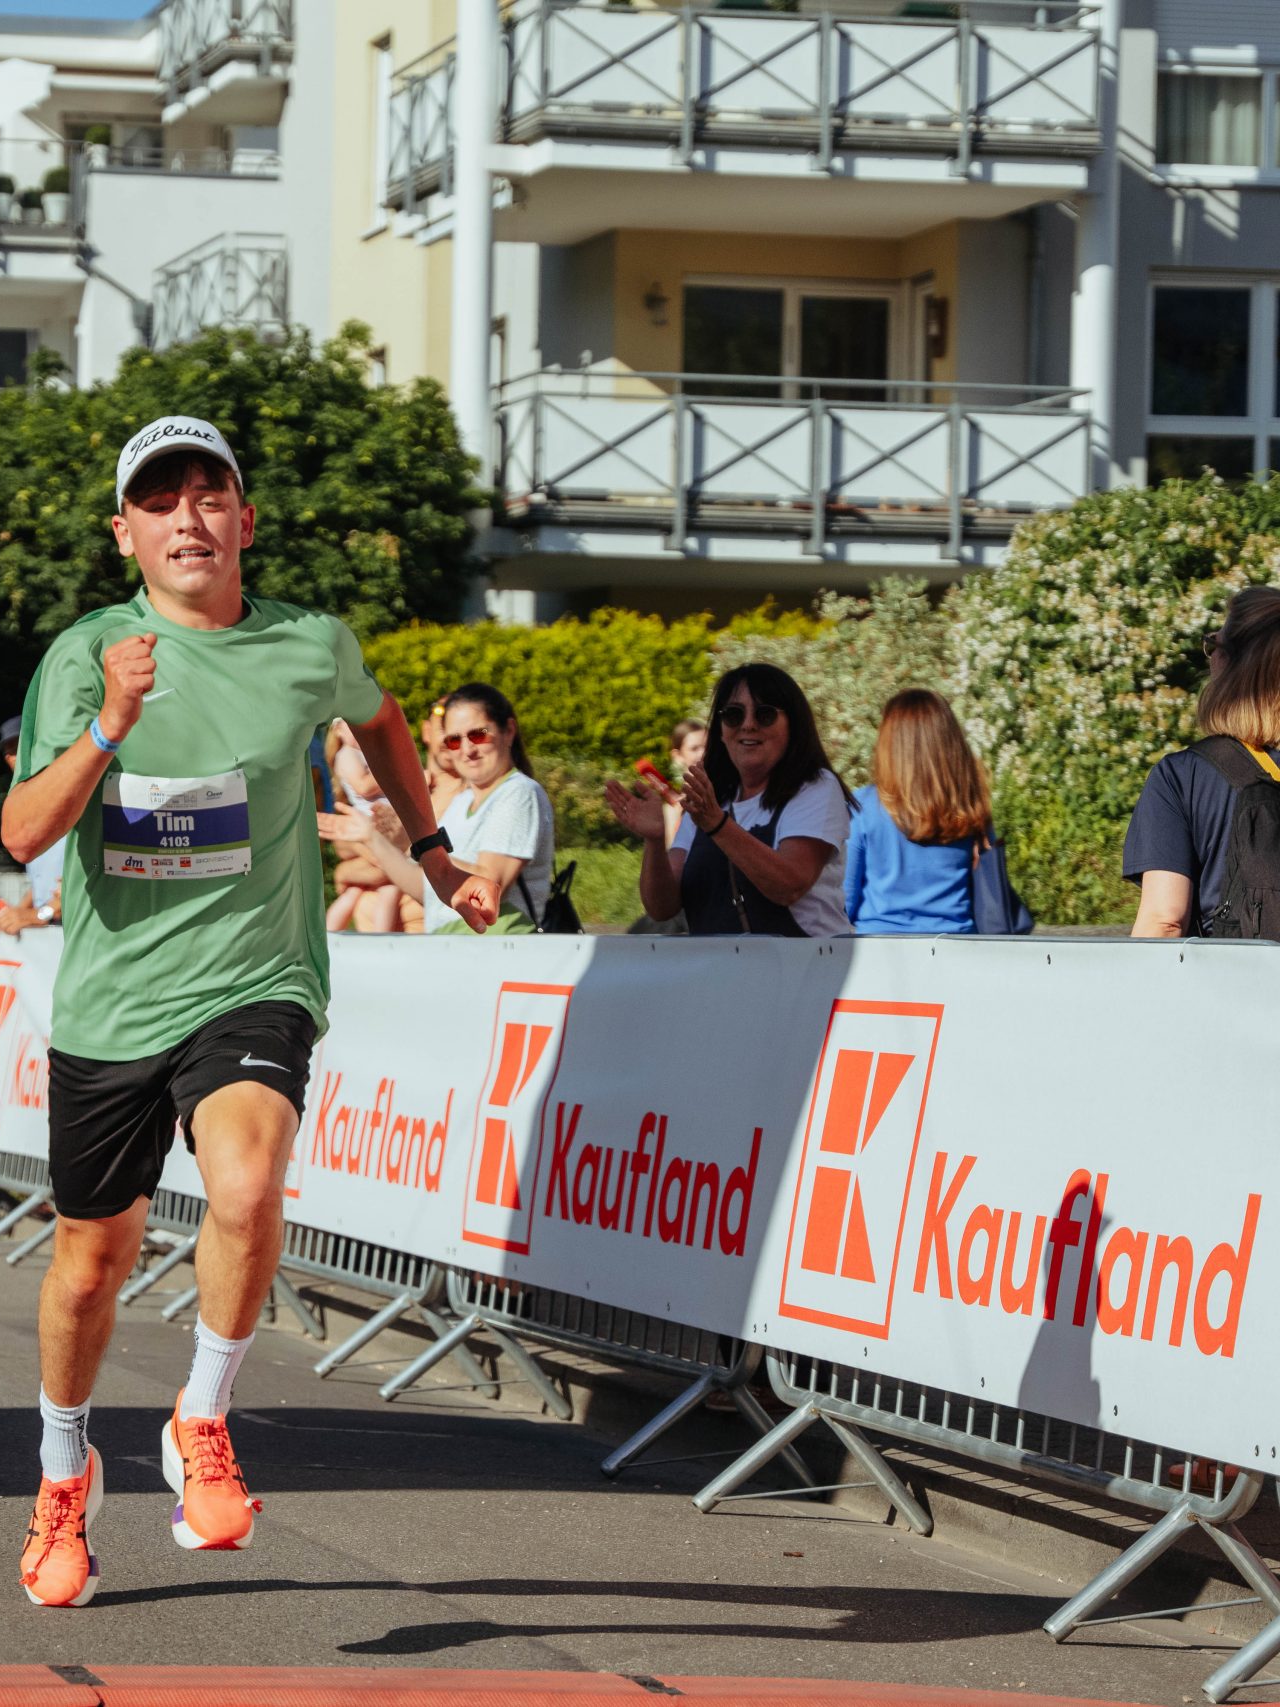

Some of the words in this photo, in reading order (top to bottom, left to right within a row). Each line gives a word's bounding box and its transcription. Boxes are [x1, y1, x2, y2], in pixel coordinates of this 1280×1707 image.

[127, 424, 216, 466] Titleist
[152, 811, 195, 832] Tim
[159, 836, 190, 847] 4103
[124, 856, 144, 868] dm
[311, 1070, 455, 1193] Kaufland
[545, 1103, 762, 1256] Kaufland
[913, 1151, 1263, 1359] Kaufland
